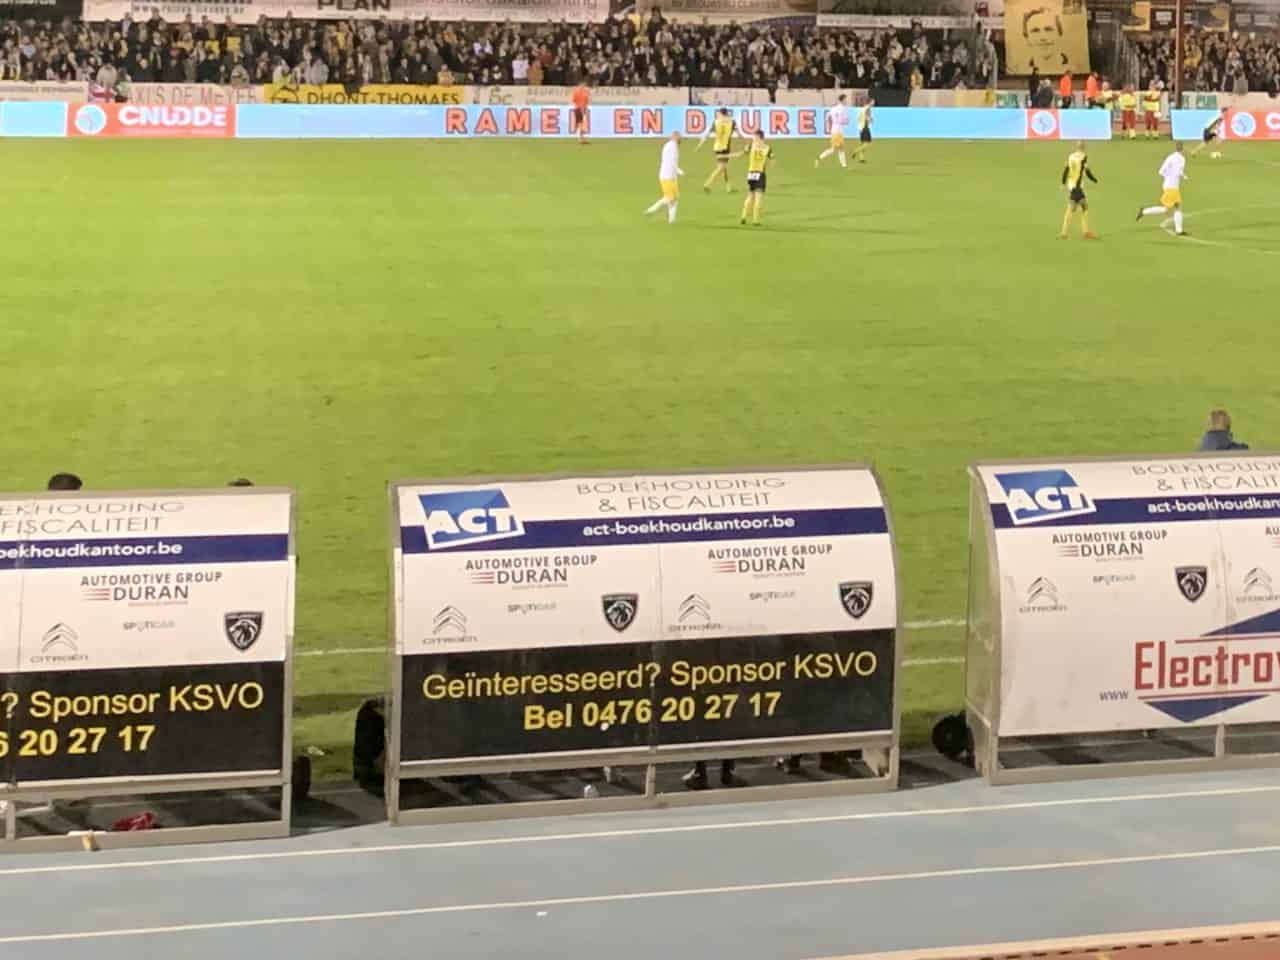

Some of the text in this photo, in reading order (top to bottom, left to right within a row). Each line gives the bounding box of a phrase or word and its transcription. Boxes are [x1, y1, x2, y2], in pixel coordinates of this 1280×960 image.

[119, 106, 228, 127] CNUDDE
[613, 108, 664, 135] EN
[685, 109, 838, 135] DURE
[576, 478, 785, 494] BOEKHOUDING
[1156, 478, 1173, 491] &
[599, 492, 771, 512] & FISCALITEIT
[1007, 486, 1086, 513] ACT
[1, 516, 163, 535] FISCALITEIT
[426, 507, 515, 535] ACT
[583, 515, 795, 536] act-boekhoudkantoor.be
[1052, 530, 1168, 544] AUTOMOTIVE GROUP
[707, 543, 833, 560] AUTOMOTIVE GROUP
[1080, 542, 1143, 557] DURAN
[465, 554, 598, 570] AUTOMOTIVE GROUP
[738, 557, 806, 573] DURAN
[81, 571, 223, 586] AUTOMOTIVE GROUP
[496, 568, 568, 584] DURAN
[113, 585, 190, 601] DURAN
[422, 651, 877, 699] Geïnteresseerd? Sponsor KSVO
[29, 690, 161, 723] Sponsor
[169, 682, 264, 712] KSVO
[524, 691, 782, 730] Bel 0476 20 27 17
[19, 729, 58, 756] 20
[67, 727, 107, 754] 27
[118, 725, 156, 752] 17
